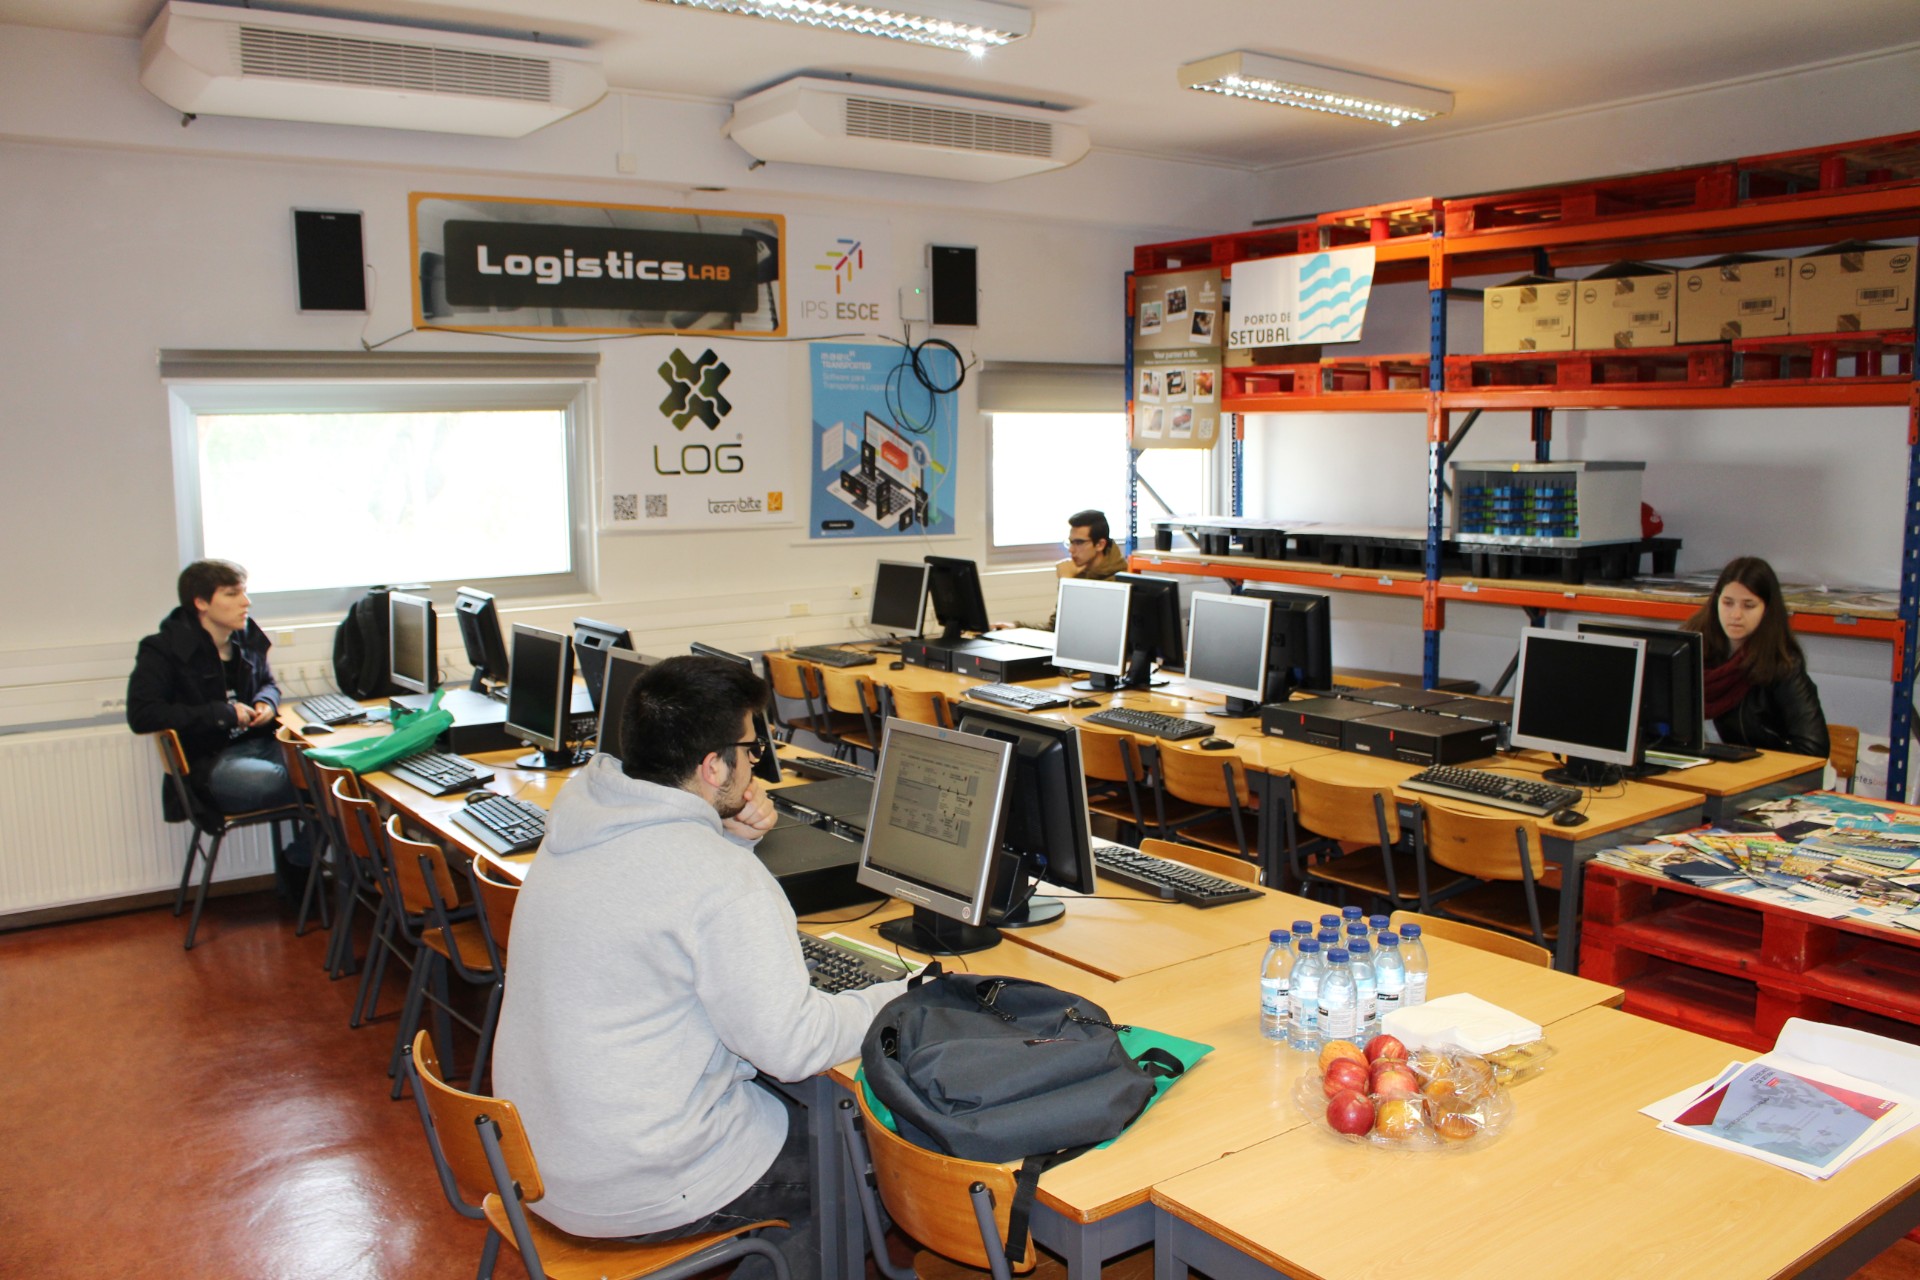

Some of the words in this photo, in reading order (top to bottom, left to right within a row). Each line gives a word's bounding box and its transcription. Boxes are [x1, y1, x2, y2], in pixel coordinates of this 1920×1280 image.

[477, 244, 687, 285] Logistics
[687, 264, 731, 281] LAB
[800, 299, 829, 320] IPS
[836, 302, 880, 321] ESCE
[1244, 313, 1278, 326] PORTO
[1280, 311, 1291, 323] DE
[653, 443, 744, 475] LOG
